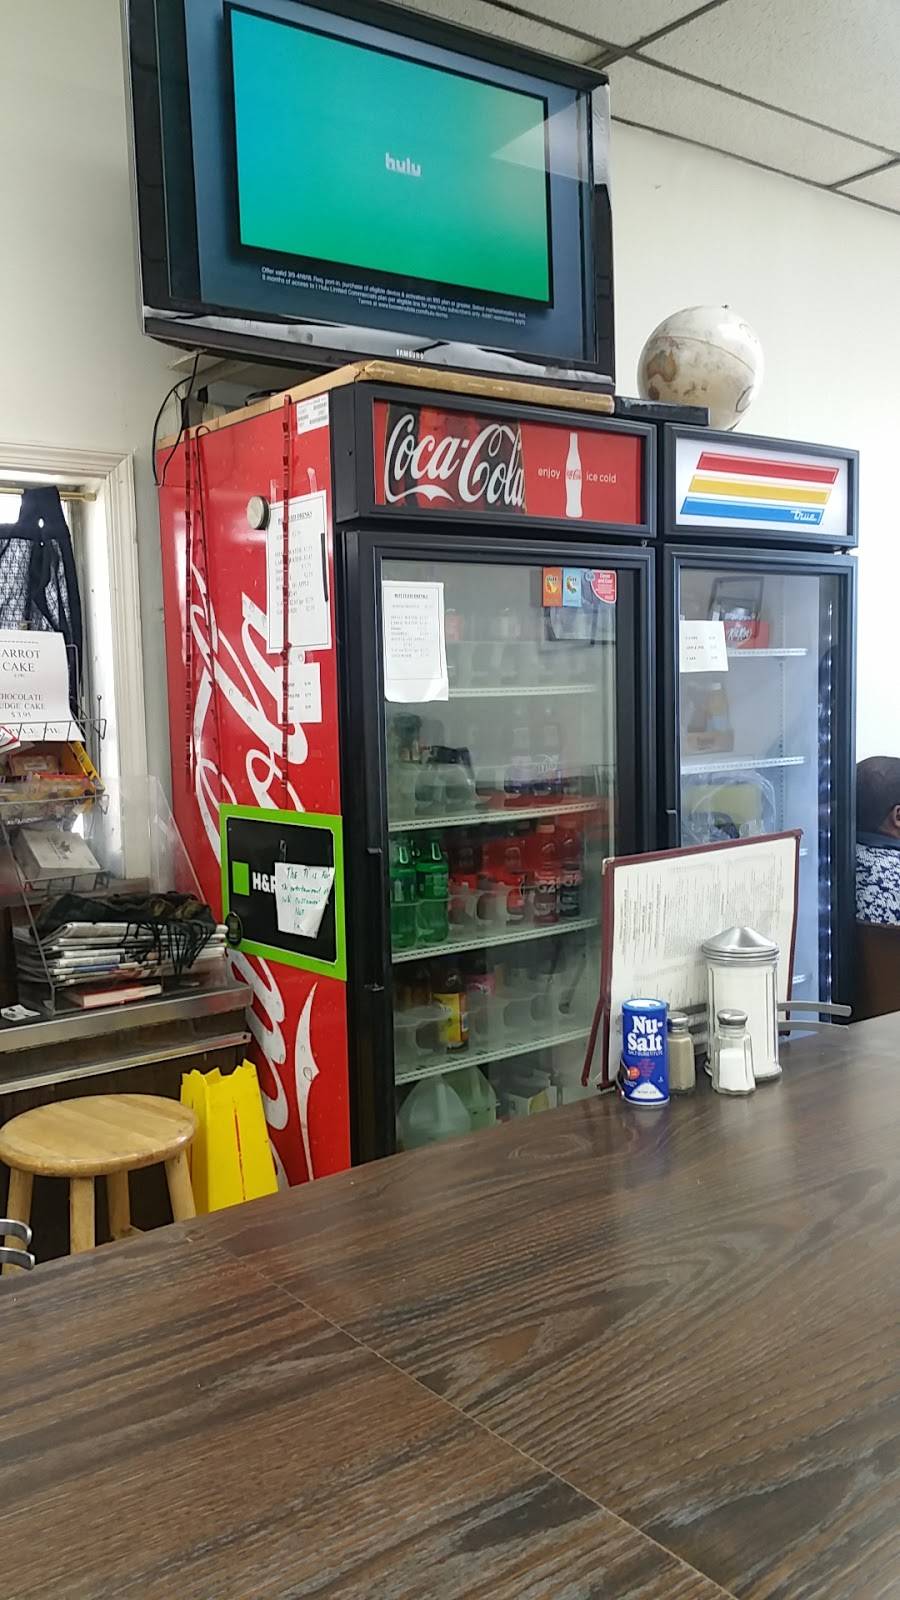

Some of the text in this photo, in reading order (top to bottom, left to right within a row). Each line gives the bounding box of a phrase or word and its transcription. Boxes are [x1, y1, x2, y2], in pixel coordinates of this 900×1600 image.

[385, 152, 421, 177] hulu
[384, 414, 524, 506] Coca-Cola
[537, 468, 560, 480] enjoy
[586, 472, 598, 482] ice
[600, 474, 617, 484] cold
[2, 662, 35, 672] CAKE
[632, 1015, 663, 1034] Nu-
[627, 1032, 662, 1052] Salt
